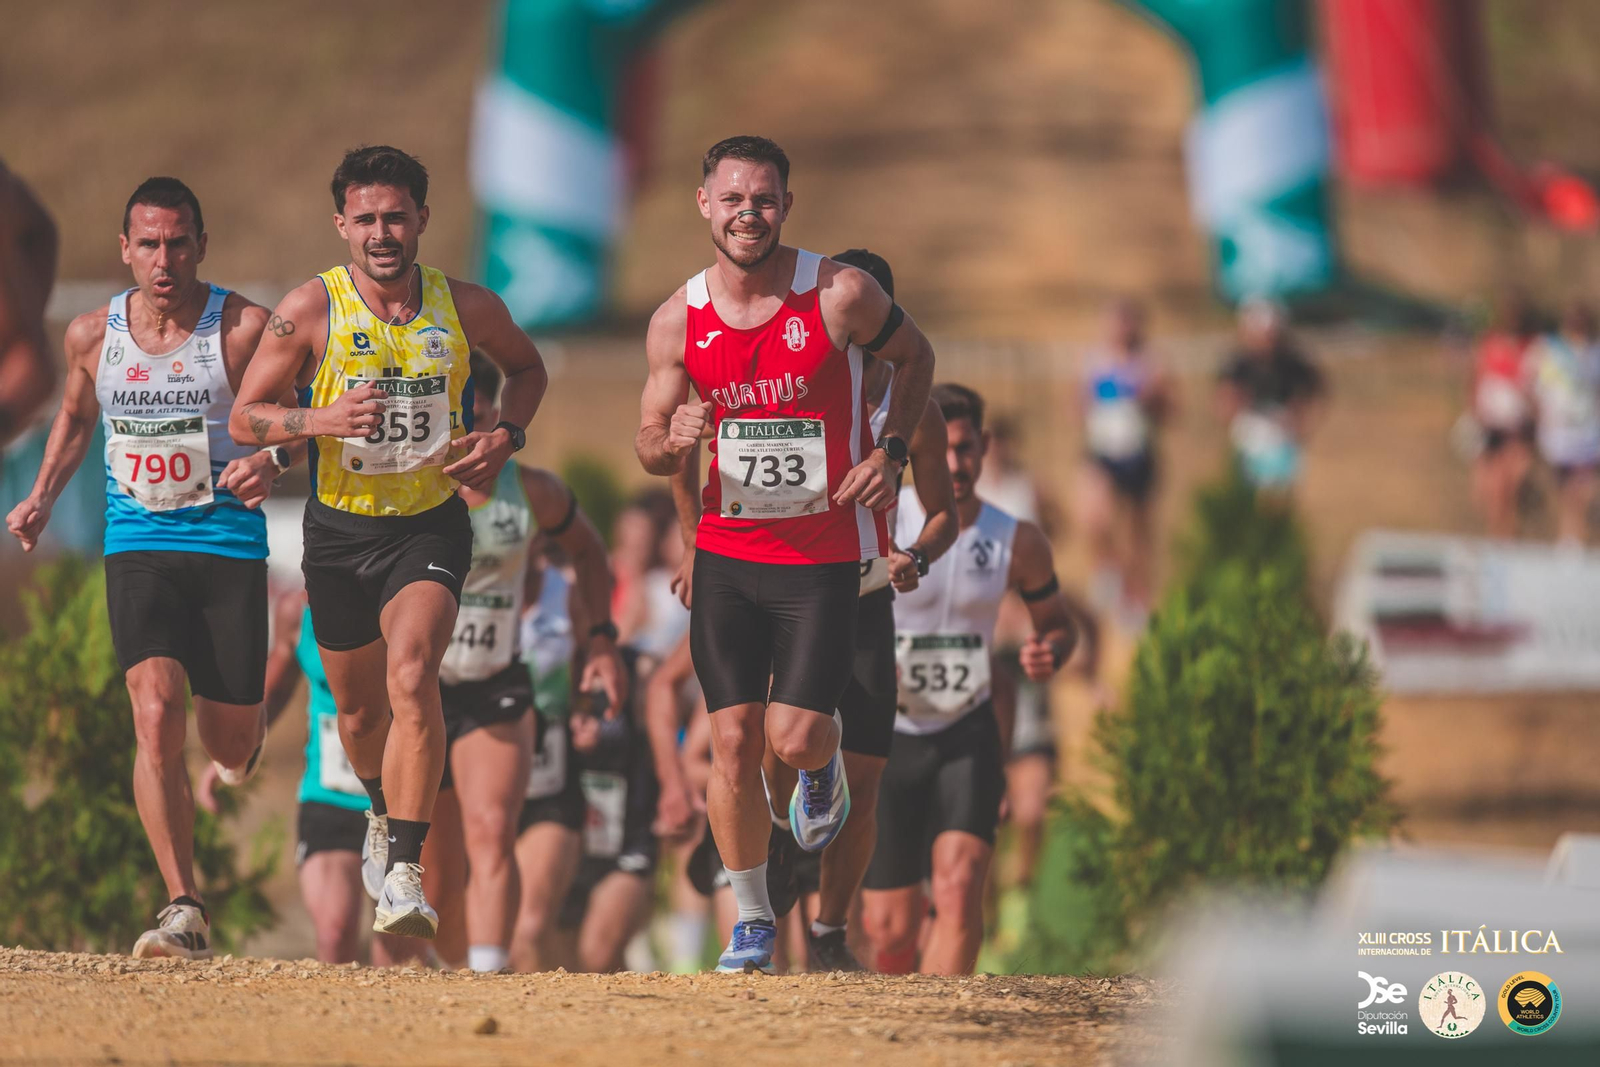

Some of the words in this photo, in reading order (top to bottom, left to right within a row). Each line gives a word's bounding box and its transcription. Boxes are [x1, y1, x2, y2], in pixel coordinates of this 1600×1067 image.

[112, 389, 211, 406] MARACENA
[376, 381, 424, 394] ITÁLICA
[712, 372, 809, 409] CURTIUS
[129, 420, 177, 434] ITÁLICA
[745, 423, 795, 436] ITÁLICA
[125, 452, 191, 485] 790
[739, 454, 807, 487] 733
[449, 623, 497, 652] 44
[909, 663, 970, 693] 532
